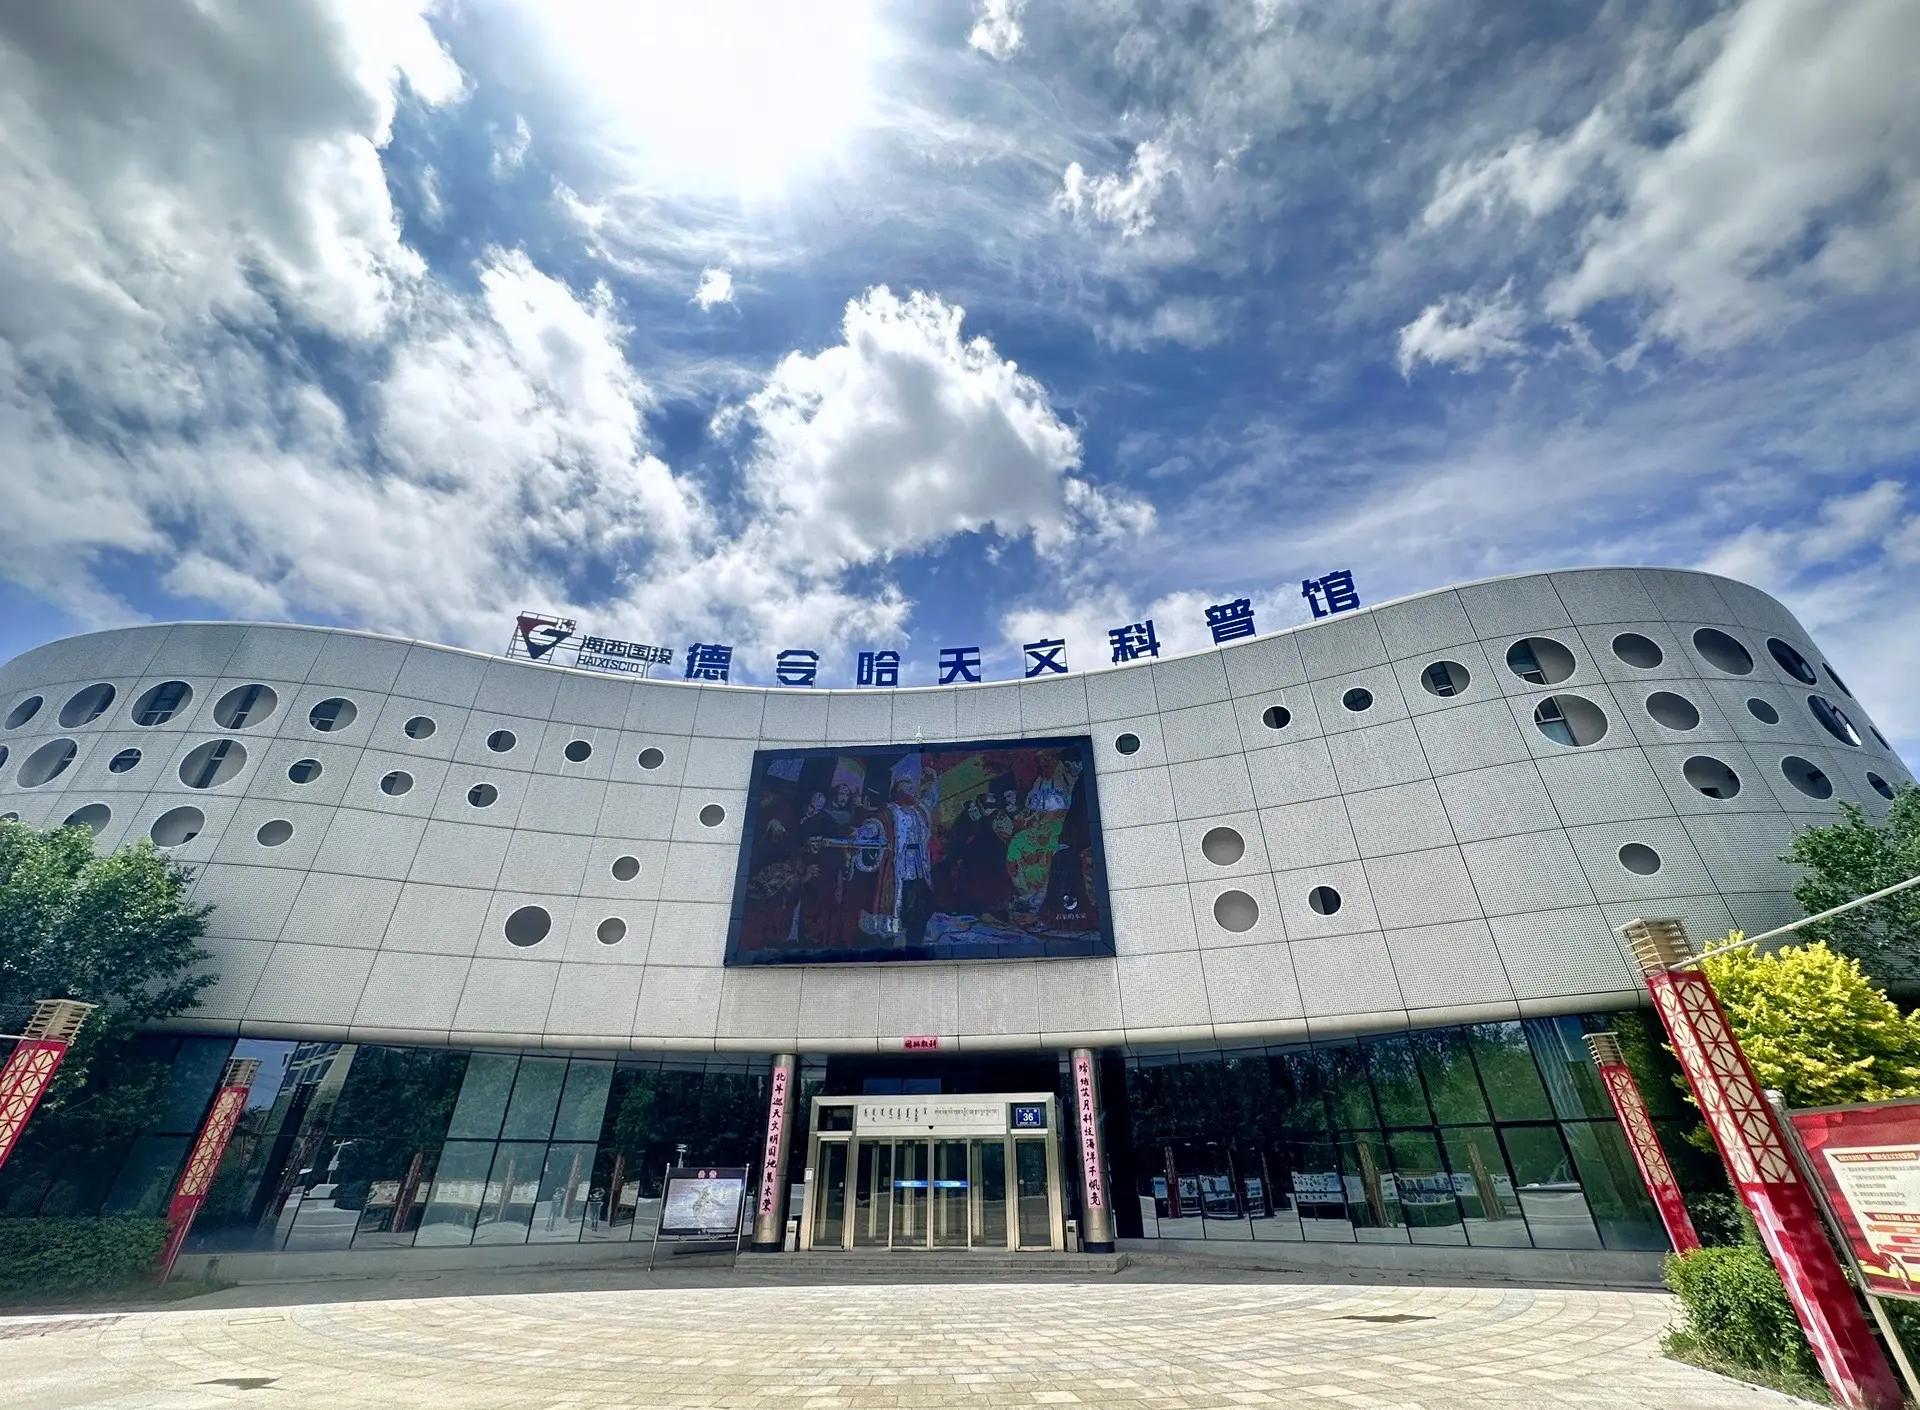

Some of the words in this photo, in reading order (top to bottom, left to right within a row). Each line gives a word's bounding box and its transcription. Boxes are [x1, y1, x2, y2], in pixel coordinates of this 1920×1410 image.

[686, 570, 1361, 686] 德令哈天文科普馆
[580, 635, 674, 665] 海西国投
[1023, 1112, 1034, 1122] 36
